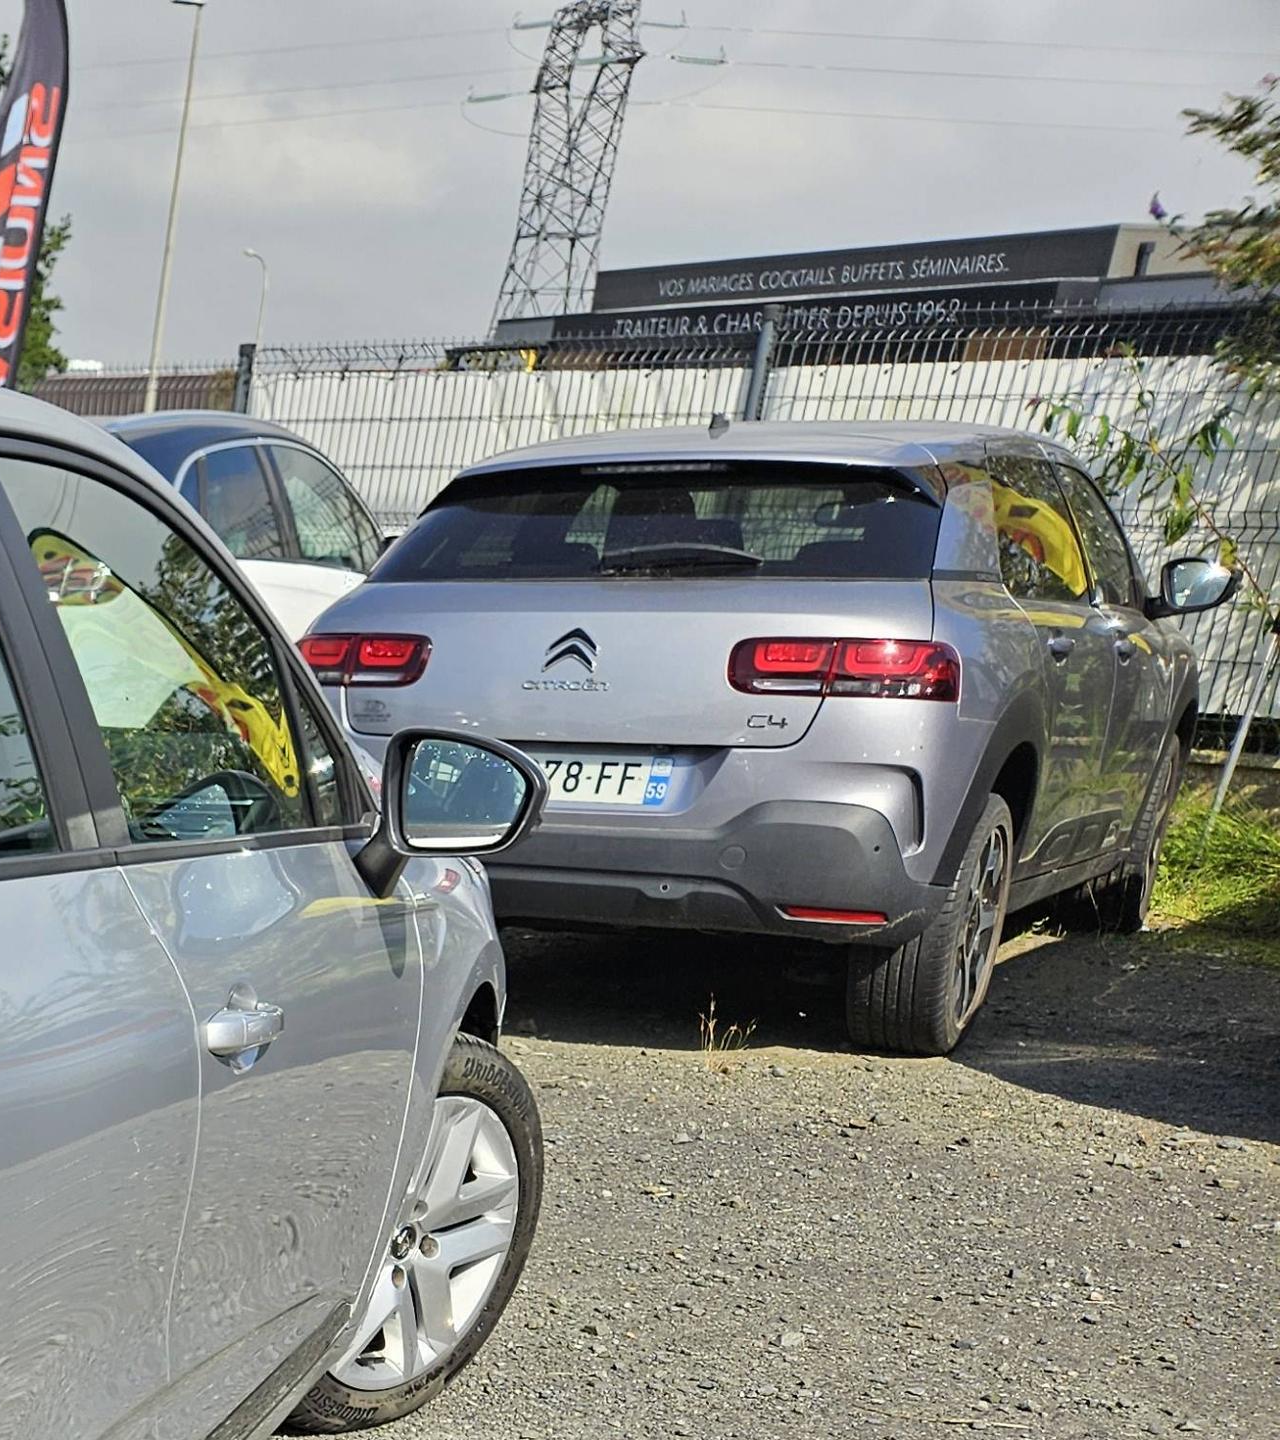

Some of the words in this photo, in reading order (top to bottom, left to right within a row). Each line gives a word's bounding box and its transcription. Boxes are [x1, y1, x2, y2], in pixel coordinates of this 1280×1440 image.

[658, 279, 685, 296] VOS
[615, 316, 690, 338] TRAITEUR
[695, 315, 708, 335] &
[837, 302, 908, 328] DEPUIS
[746, 715, 788, 729] C4
[538, 757, 642, 795] 78-FF
[645, 782, 668, 800] 59
